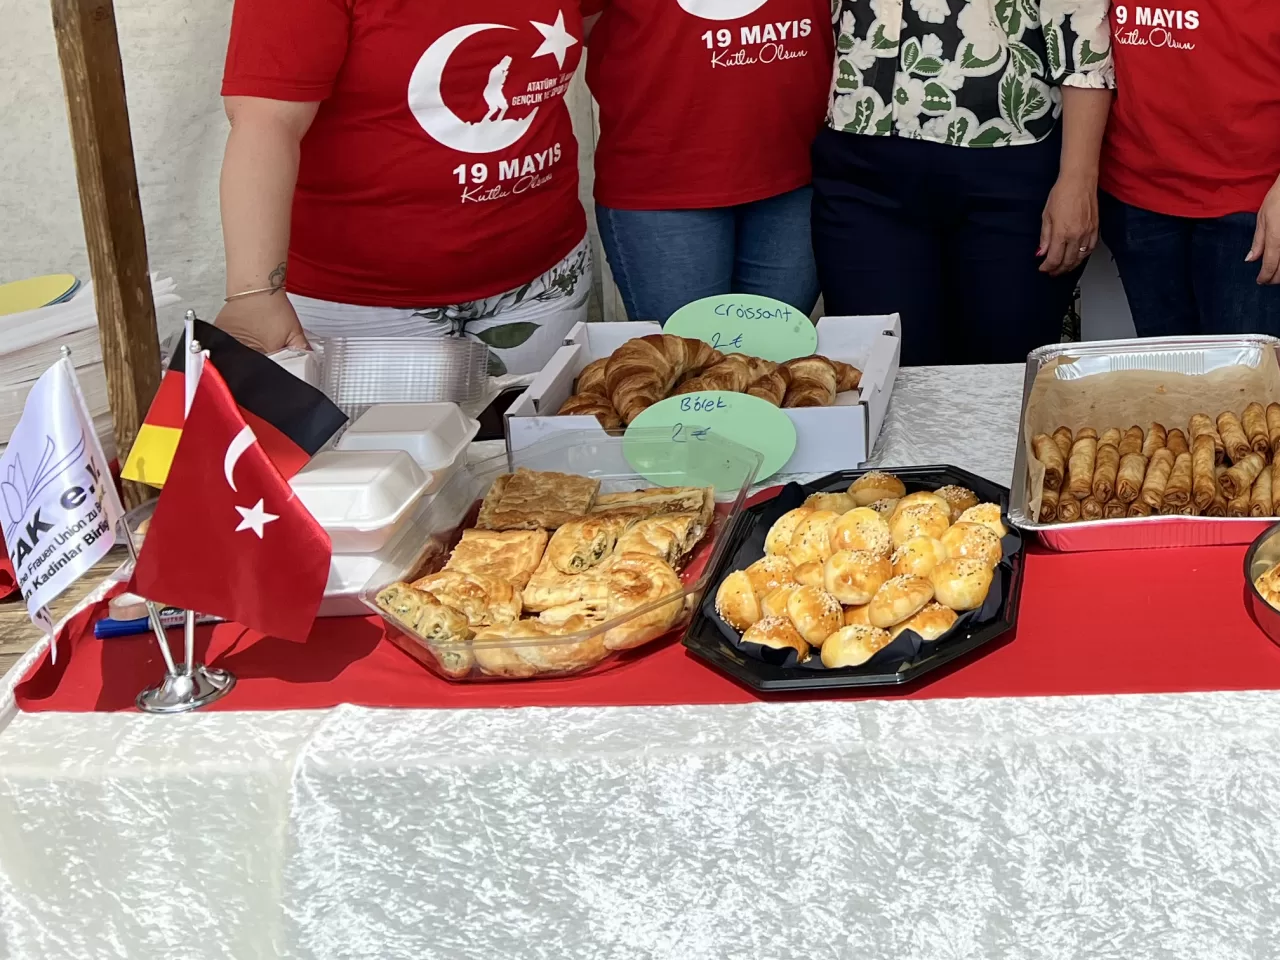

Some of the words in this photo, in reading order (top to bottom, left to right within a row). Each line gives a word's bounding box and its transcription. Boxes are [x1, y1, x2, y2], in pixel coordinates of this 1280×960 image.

[701, 28, 732, 49] 19
[740, 18, 813, 46] MAYIS
[1135, 6, 1200, 30] MAYIS
[452, 162, 489, 186] 19
[498, 142, 563, 182] MAYIS
